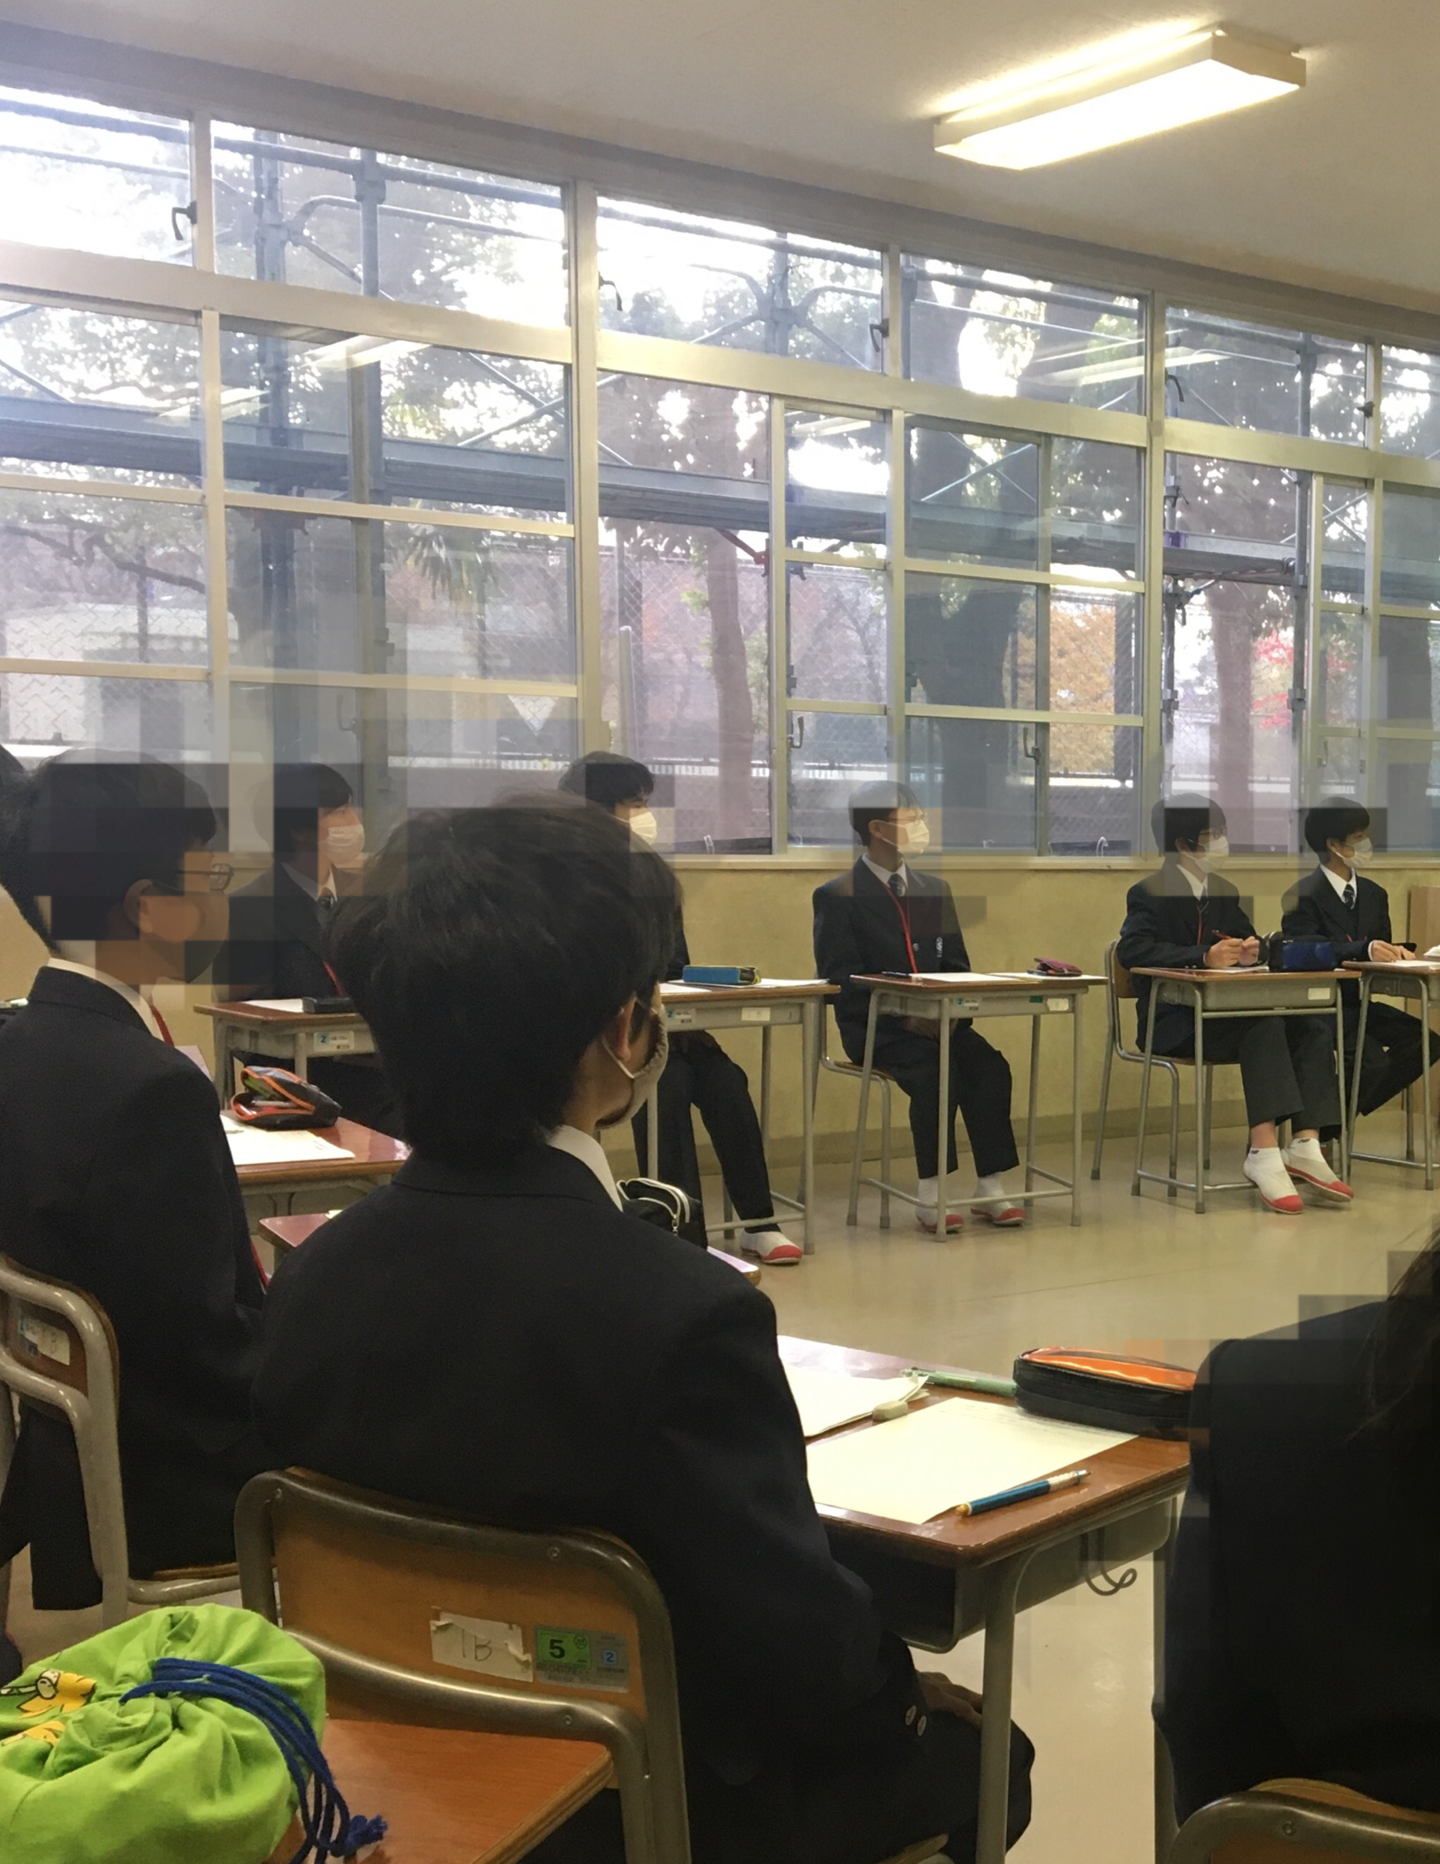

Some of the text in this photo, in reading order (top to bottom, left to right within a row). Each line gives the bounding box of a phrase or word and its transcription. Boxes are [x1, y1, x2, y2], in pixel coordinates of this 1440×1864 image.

[320, 1034, 327, 1044] 2
[549, 1638, 565, 1659] 5
[606, 1652, 614, 1663] 2
